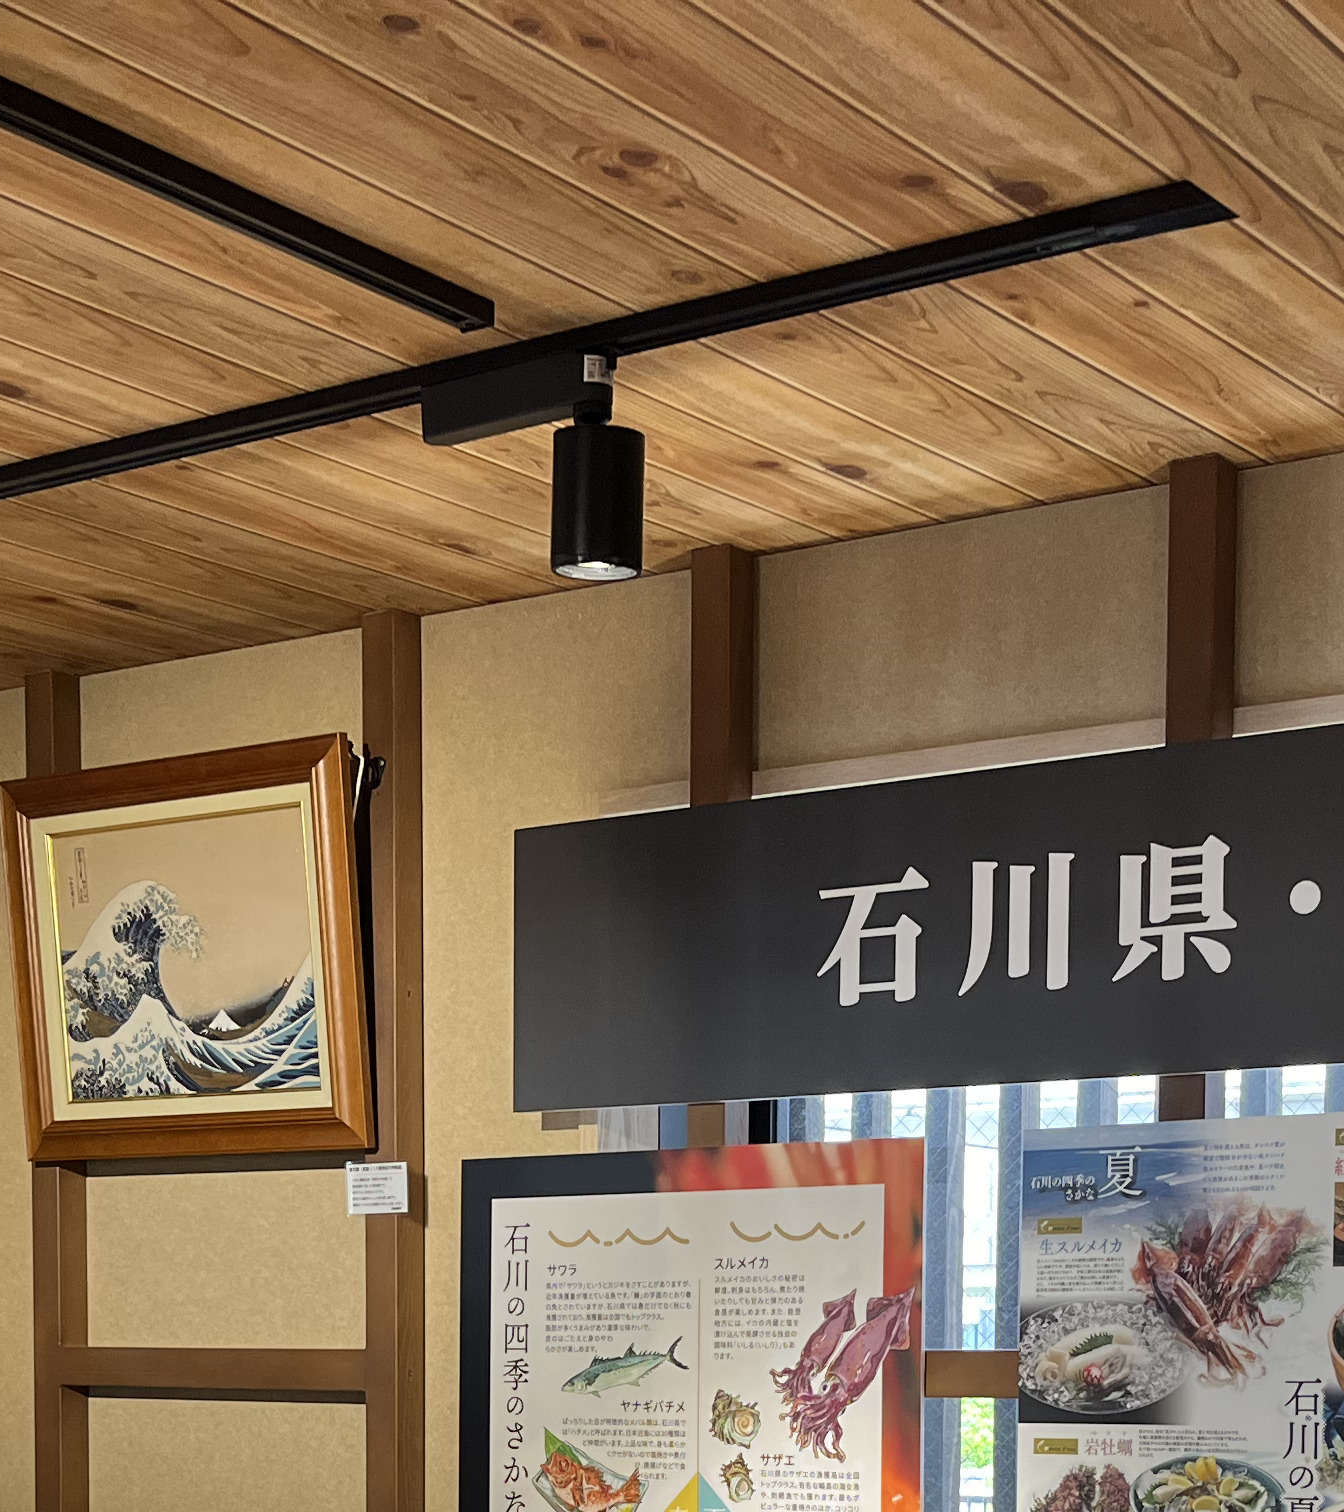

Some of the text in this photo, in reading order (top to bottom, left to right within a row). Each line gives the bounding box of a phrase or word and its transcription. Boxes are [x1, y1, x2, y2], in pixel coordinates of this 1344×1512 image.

[1098, 1146, 1144, 1199] 夏
[1030, 1174, 1096, 1190] 石川の四季の
[1065, 1187, 1097, 1202] さかな
[1039, 1239, 1123, 1256] 生スルメイカ
[547, 1263, 577, 1277] サワラ
[714, 1257, 769, 1270] スルメイカ
[759, 1453, 796, 1467] サザエ
